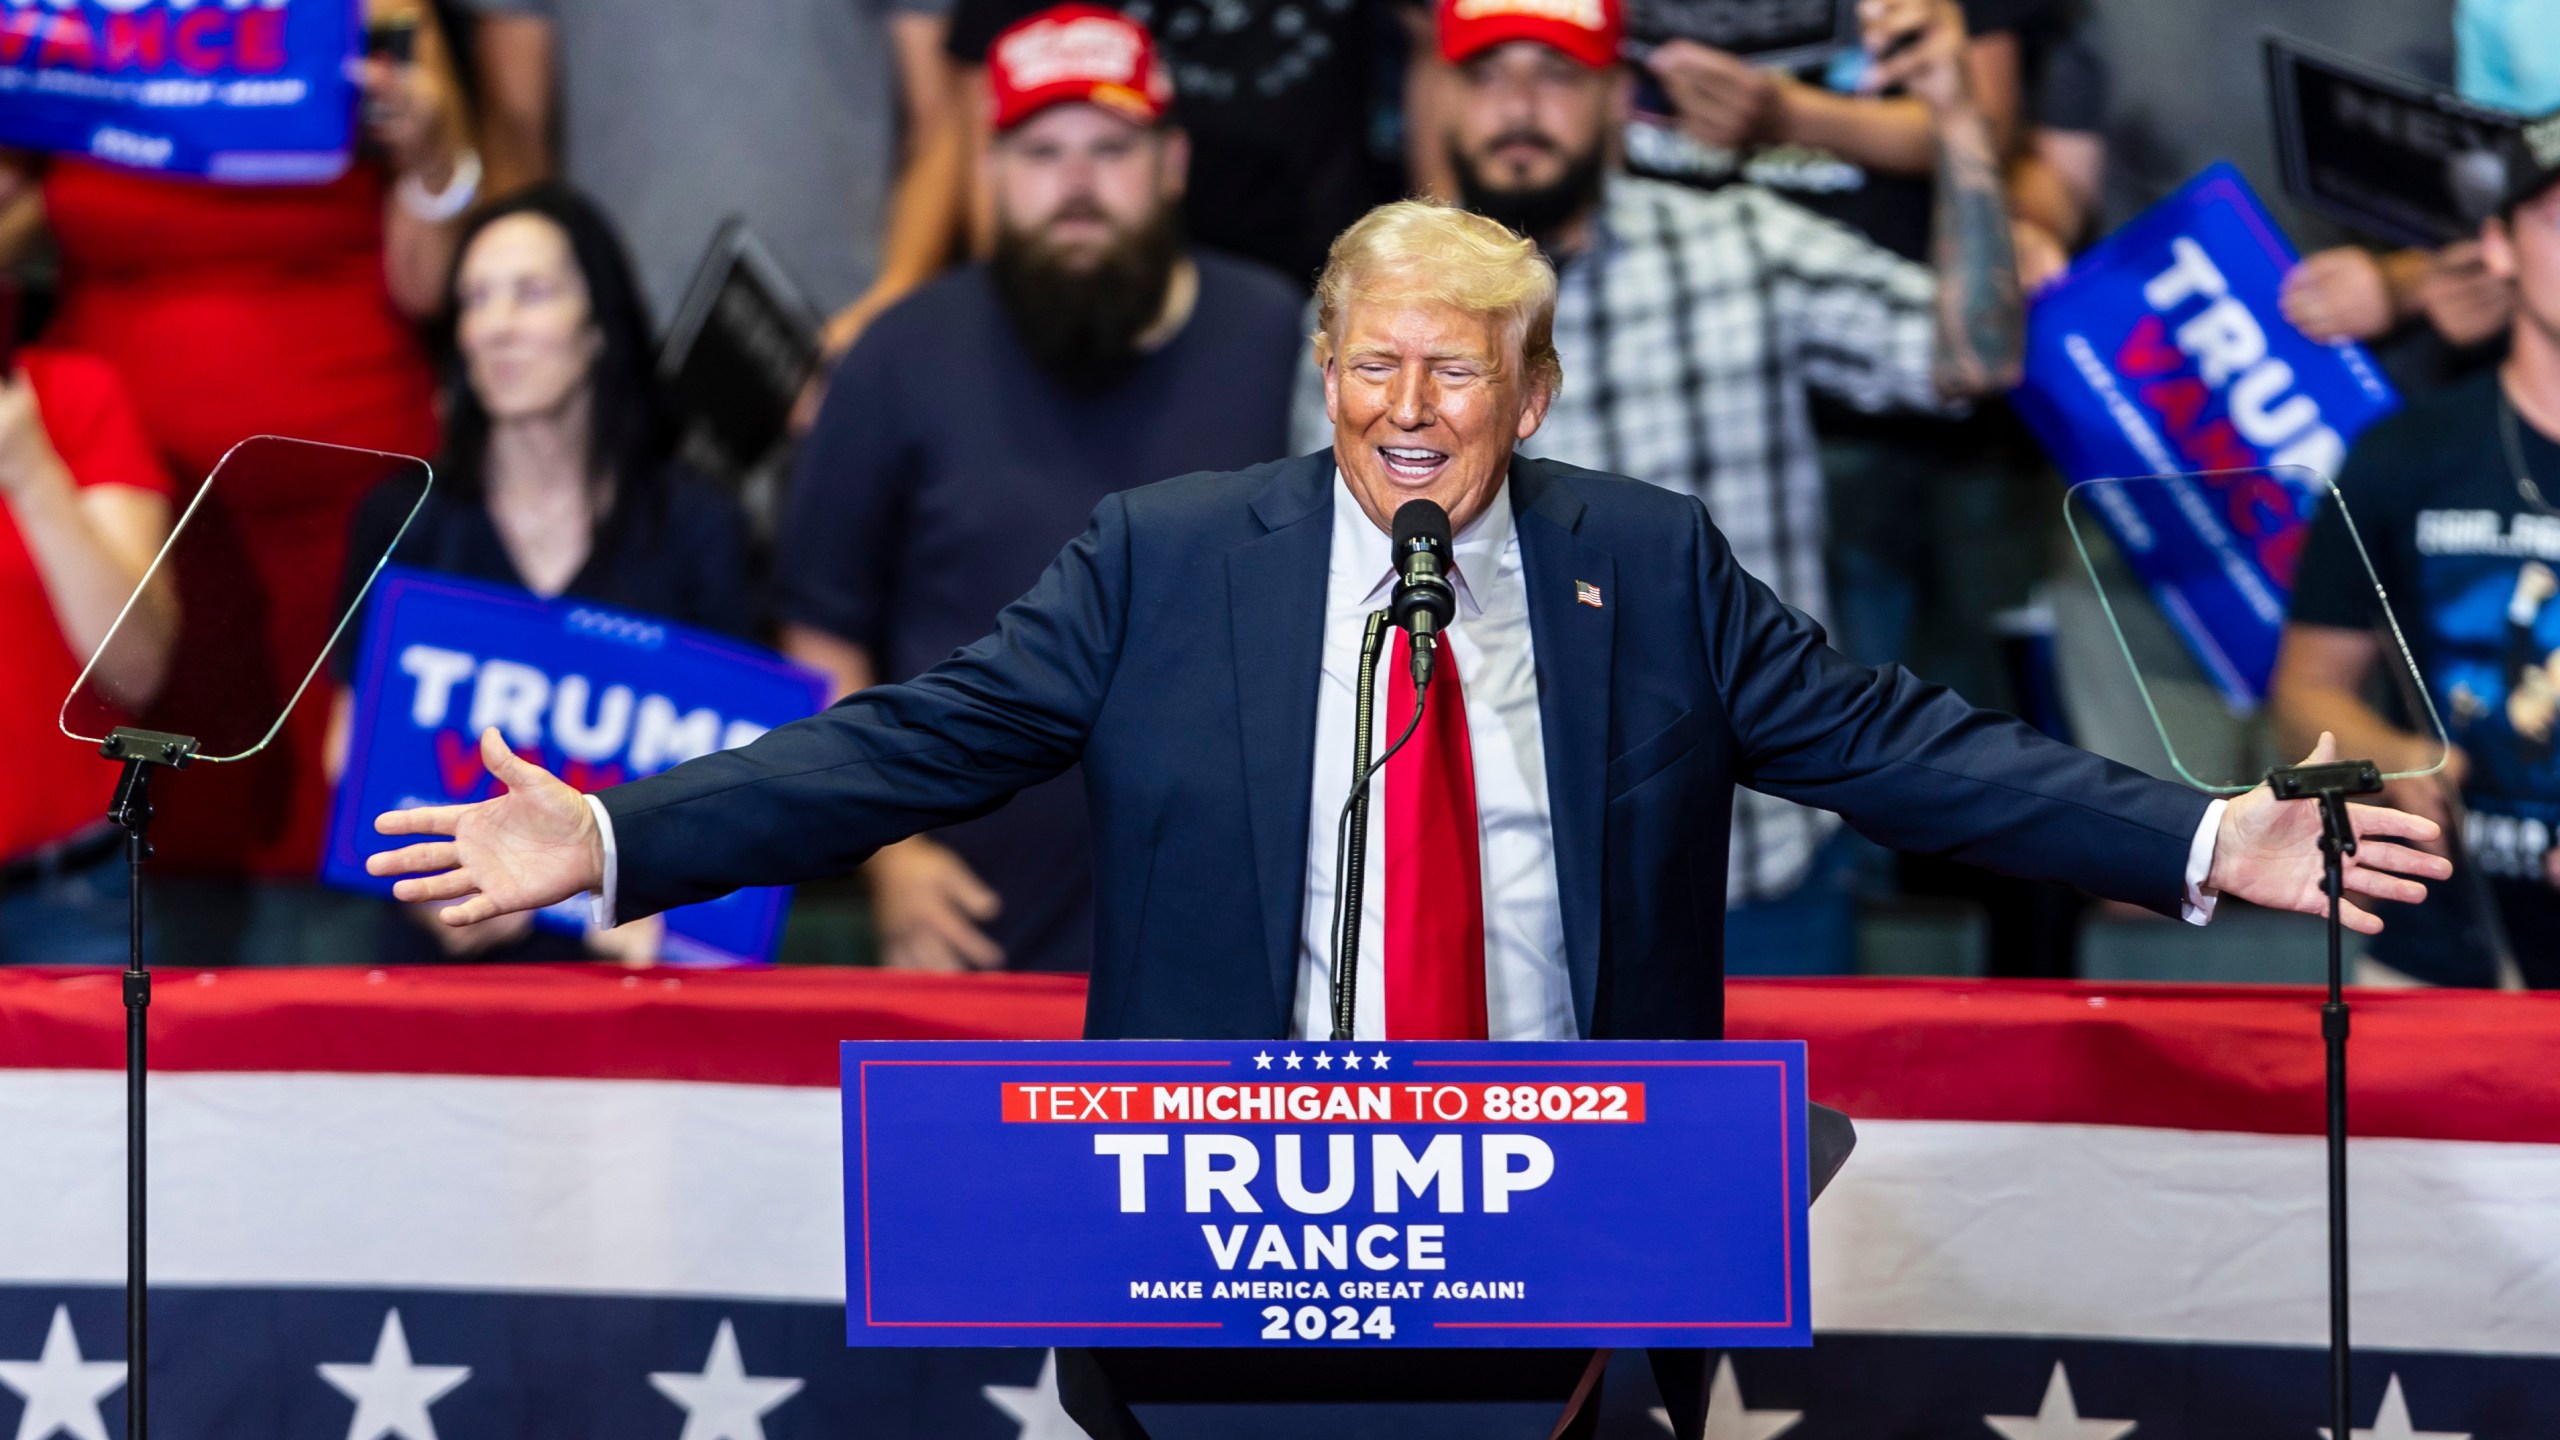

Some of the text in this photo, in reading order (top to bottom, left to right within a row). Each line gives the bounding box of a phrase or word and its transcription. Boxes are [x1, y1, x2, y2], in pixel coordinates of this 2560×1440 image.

[1019, 1085, 1629, 1121] TEXT MICHIGAN TO 88022
[1094, 1133, 1556, 1215] TRUMP
[1200, 1223, 1447, 1271] VANCE
[1130, 1281, 1525, 1300] MAKE AMERICA GREAT AGAIN!
[1261, 1305, 1396, 1340] 2024
